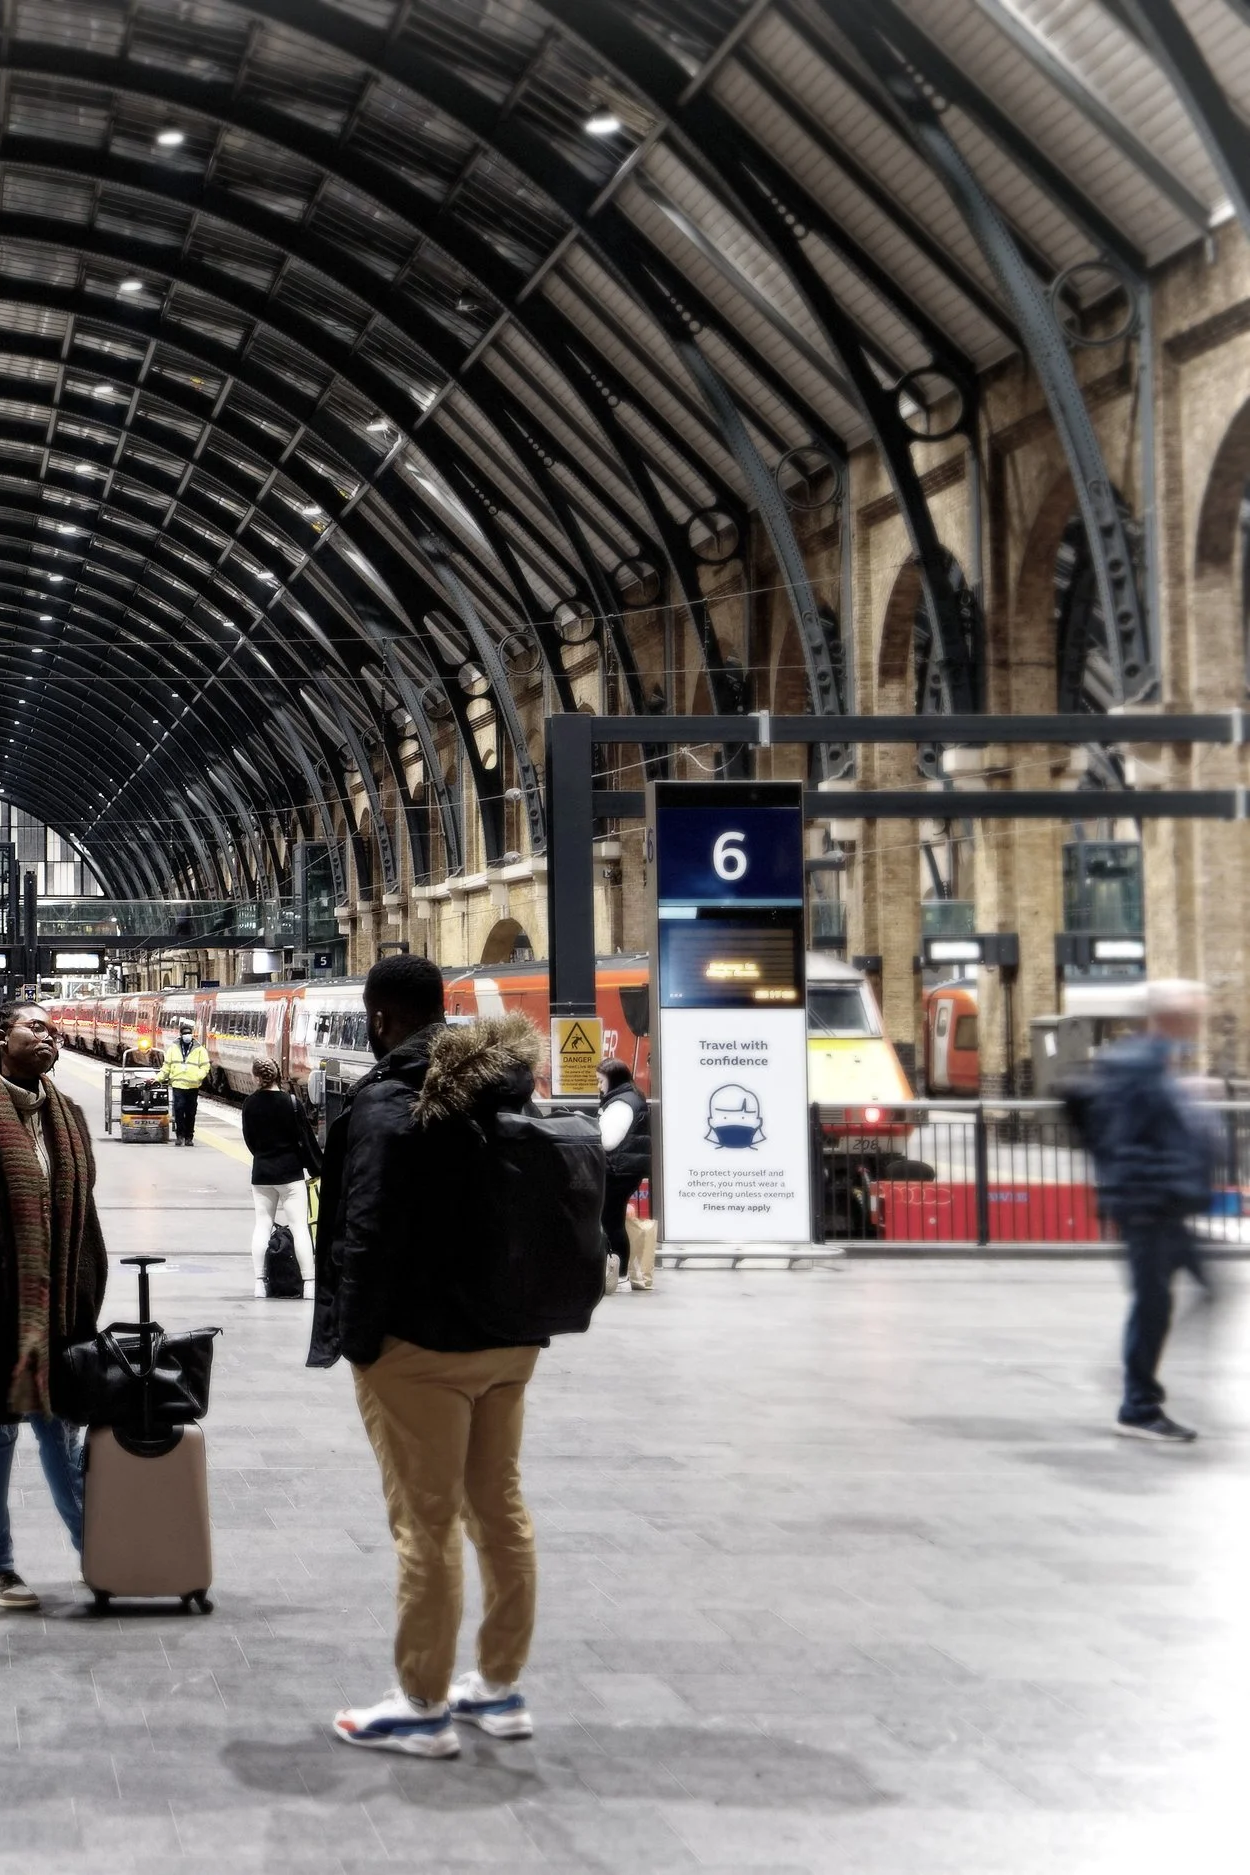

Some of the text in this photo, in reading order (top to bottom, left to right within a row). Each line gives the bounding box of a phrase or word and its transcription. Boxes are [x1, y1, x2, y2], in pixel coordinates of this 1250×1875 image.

[713, 831, 747, 881] 6
[320, 956, 327, 966] 5
[602, 1029, 619, 1059] ER
[699, 1040, 768, 1050] Travel with
[699, 1055, 769, 1066] confidence
[688, 1169, 784, 1178] To protect yourself and
[687, 1180, 716, 1188] others,
[717, 1181, 733, 1189] you
[678, 1189, 795, 1199] face covering unless exempt
[703, 1203, 771, 1213] Fines may apply
